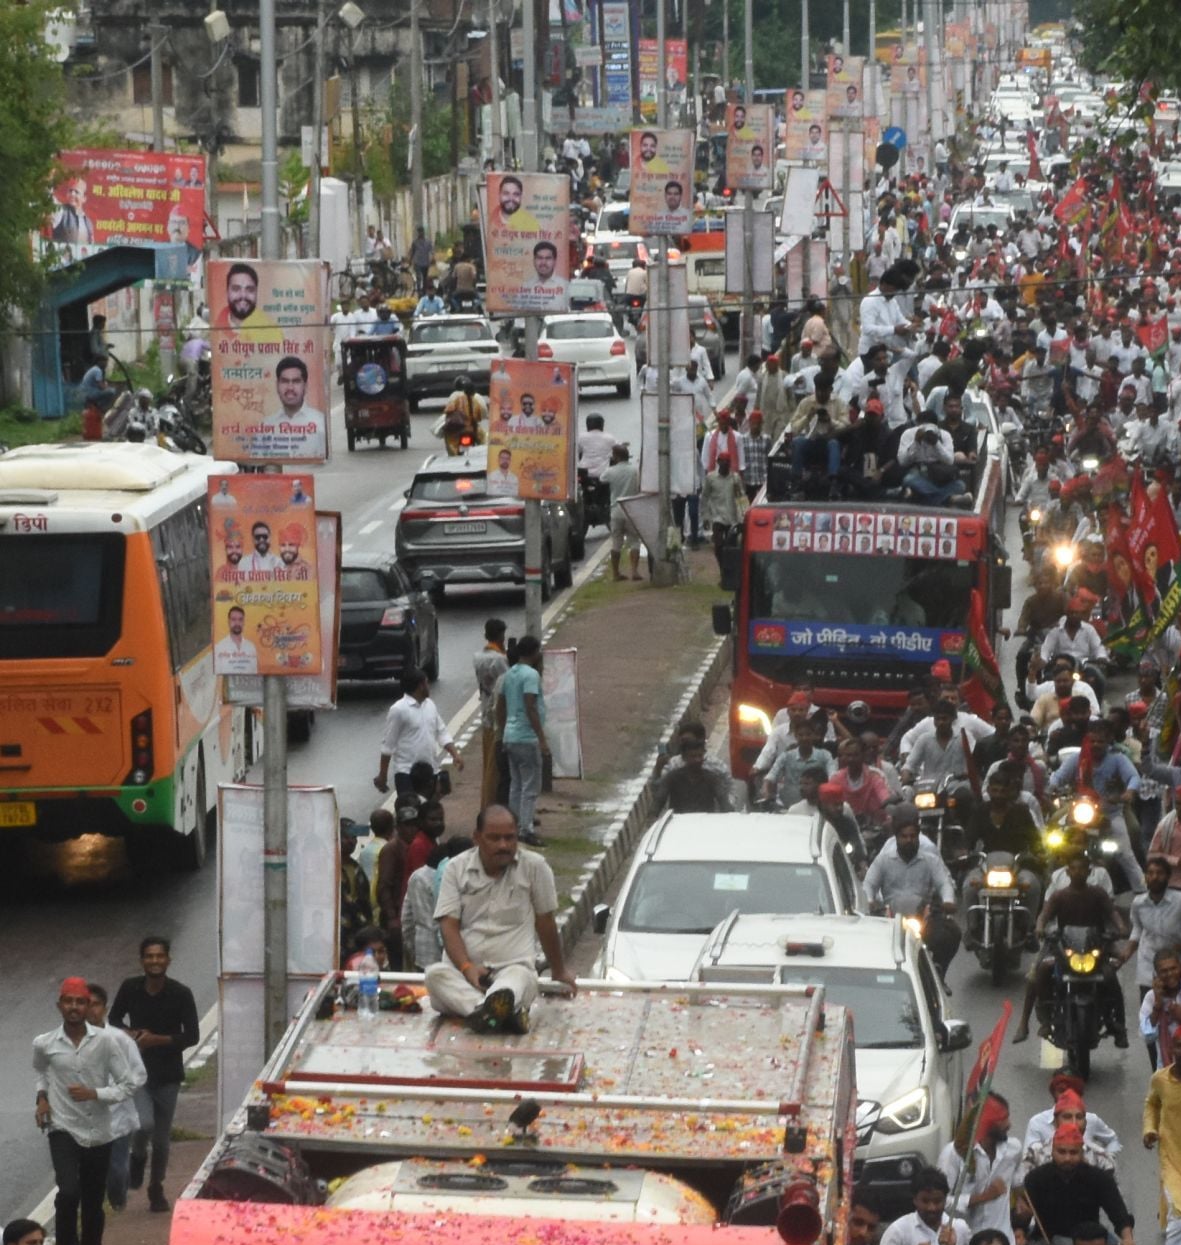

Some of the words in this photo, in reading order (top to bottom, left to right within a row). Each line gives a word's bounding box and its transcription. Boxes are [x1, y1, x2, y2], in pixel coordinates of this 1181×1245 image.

[303, 340, 313, 353] जी
[14, 513, 48, 532] डिपो
[790, 628, 812, 645] जो
[890, 631, 933, 651] पीडीए
